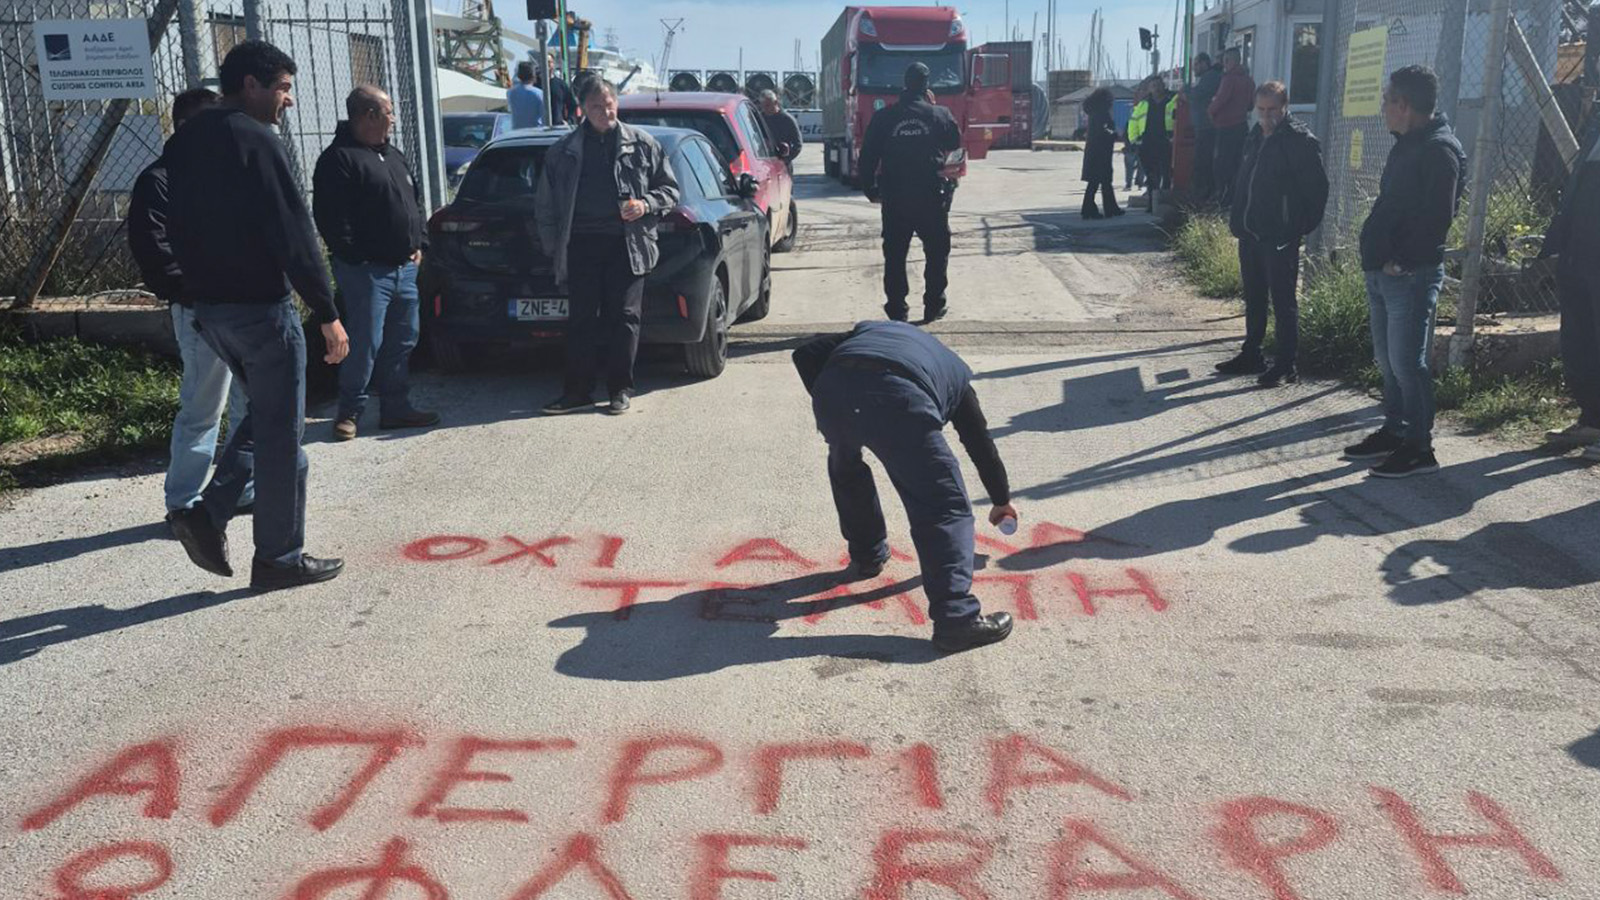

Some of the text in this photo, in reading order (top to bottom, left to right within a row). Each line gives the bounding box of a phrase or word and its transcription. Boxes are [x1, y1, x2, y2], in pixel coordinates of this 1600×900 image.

[83, 33, 115, 42] ΑΑΔΕ
[101, 68, 143, 76] ΠΕΡΙΒΟΛΟΣ
[51, 83, 87, 91] CUSTOMS
[402, 534, 624, 569] ΟΧΙ
[21, 725, 1134, 830] ΑΠΕΡΓΙΑ
